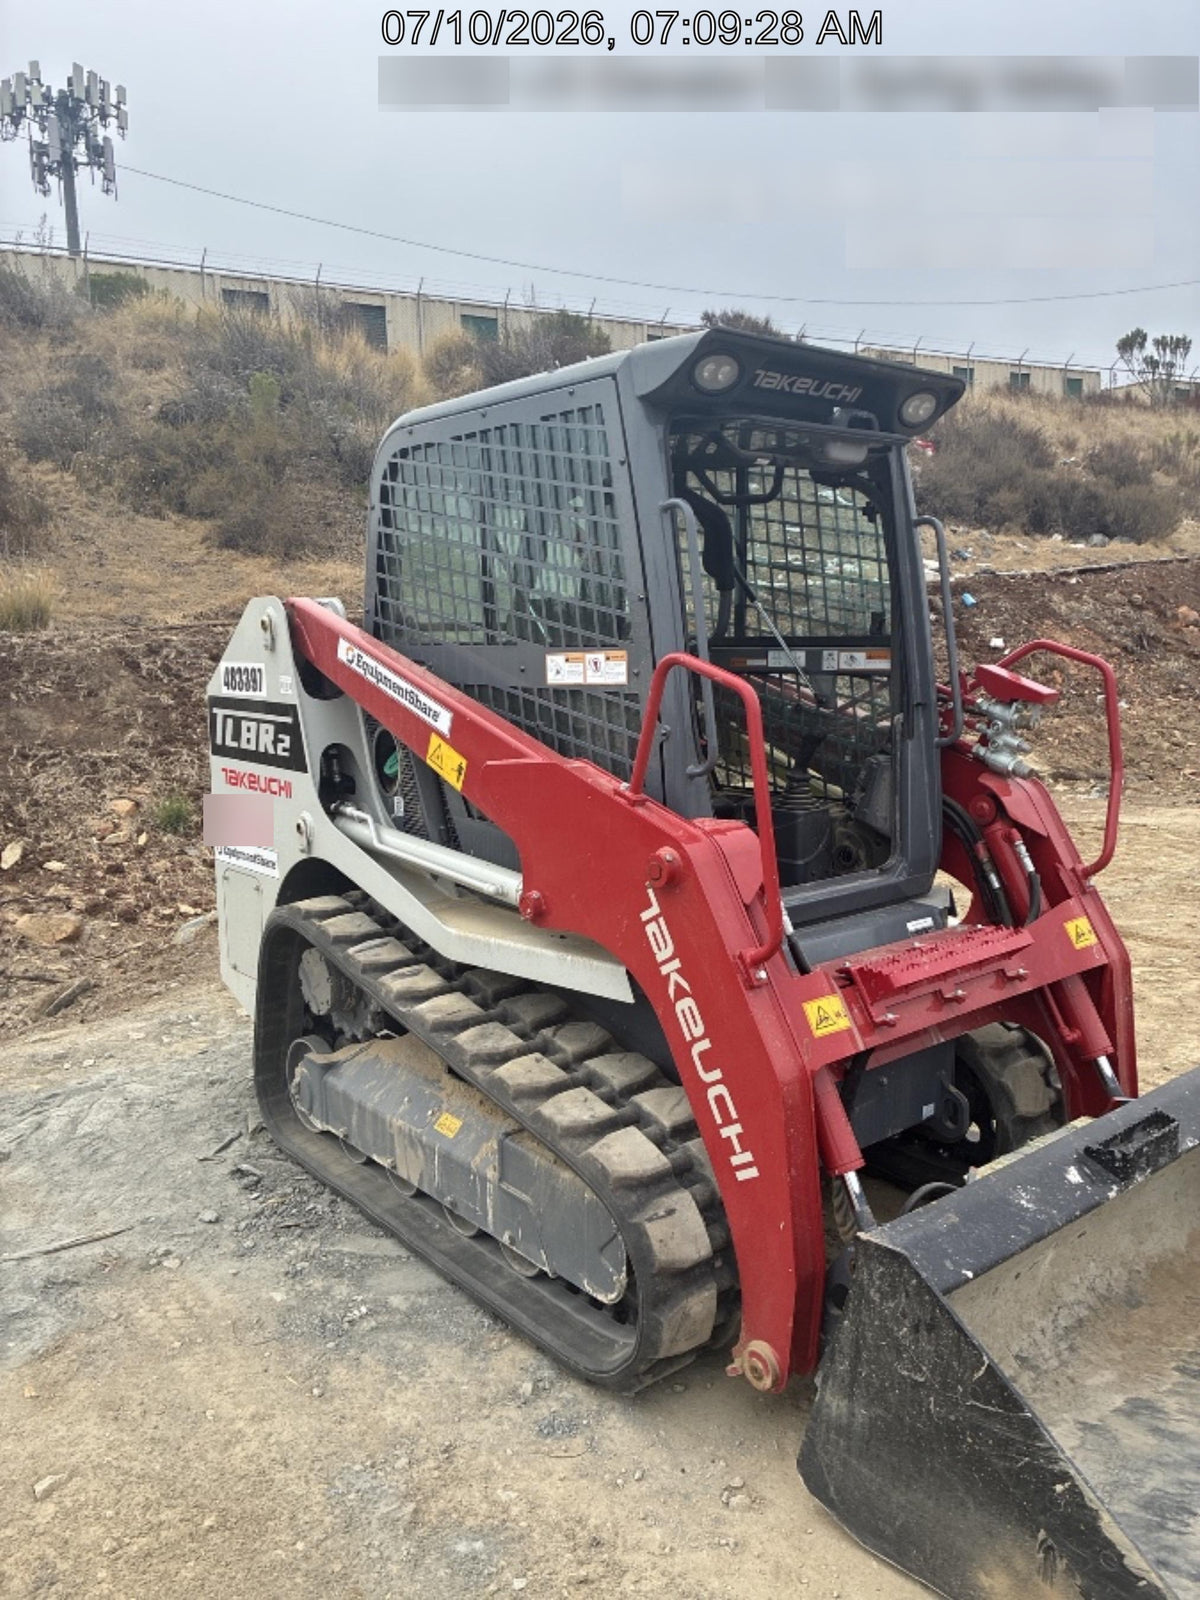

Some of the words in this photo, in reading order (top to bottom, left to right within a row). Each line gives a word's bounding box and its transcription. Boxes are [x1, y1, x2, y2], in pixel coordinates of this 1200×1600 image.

[753, 368, 863, 403] TAKEUCHI
[356, 651, 441, 723] EquipmentShare
[212, 707, 293, 757] TL8R2
[221, 767, 293, 799] TAKEUCHI
[640, 884, 760, 1182] TAKEUCHI
